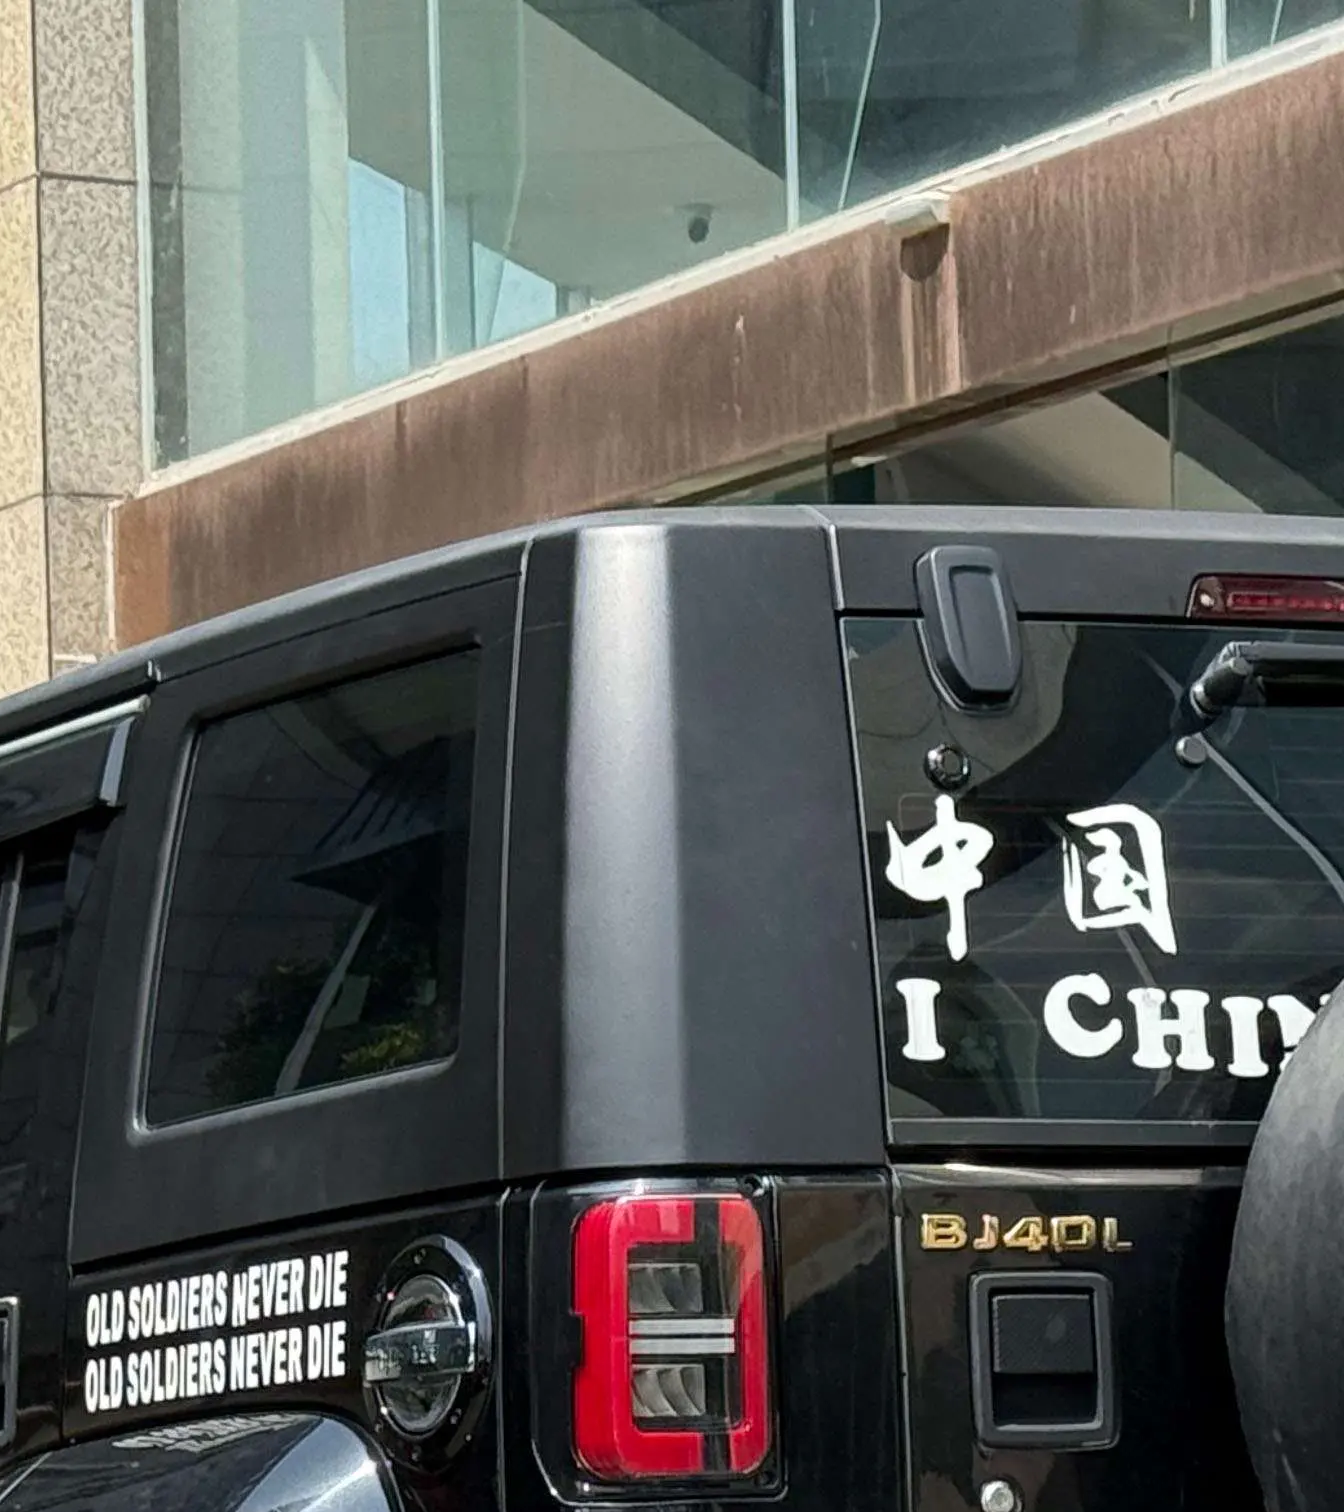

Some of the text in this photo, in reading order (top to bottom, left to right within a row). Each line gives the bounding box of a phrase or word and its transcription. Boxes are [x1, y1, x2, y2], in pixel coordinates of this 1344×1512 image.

[895, 979, 945, 1061] I
[921, 1213, 1134, 1252] BJ40L
[86, 1249, 350, 1347] OLD SOLDIERS NEVER DIE
[84, 1320, 347, 1414] OLD SOLDIERS NEVER DIE
